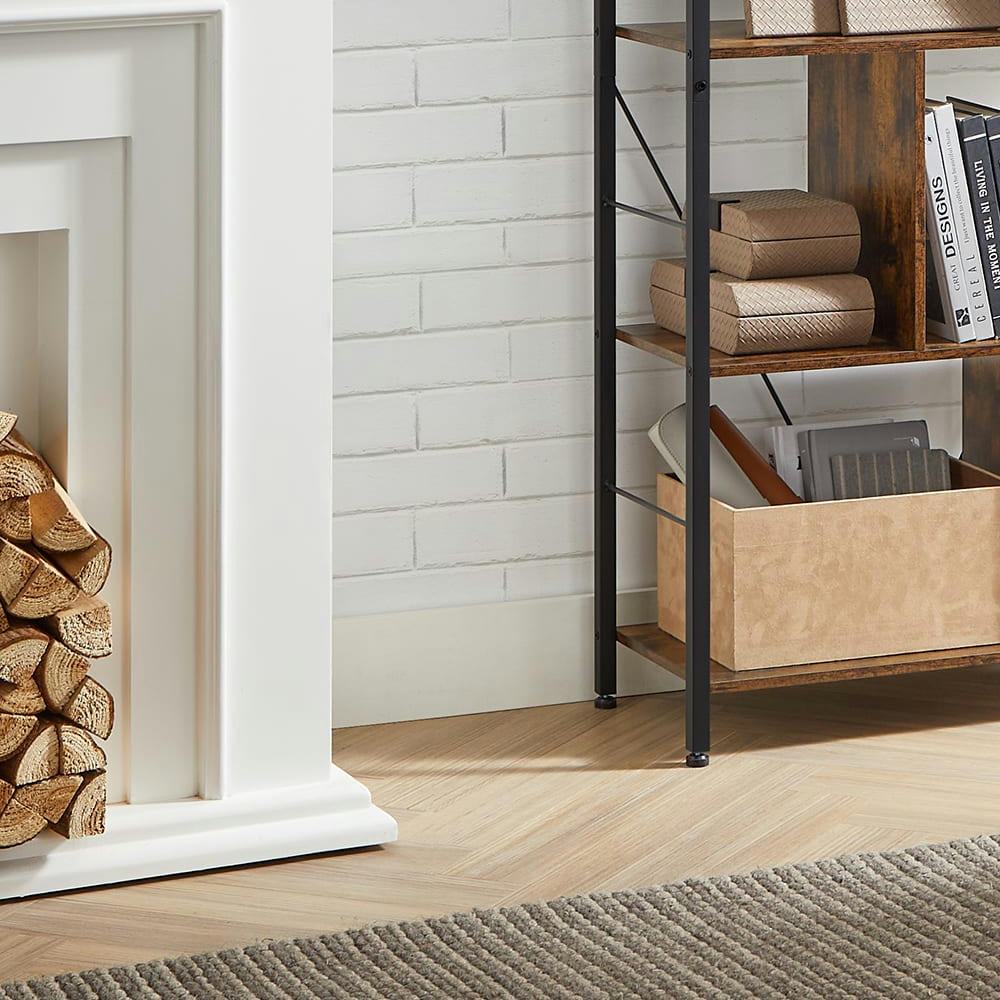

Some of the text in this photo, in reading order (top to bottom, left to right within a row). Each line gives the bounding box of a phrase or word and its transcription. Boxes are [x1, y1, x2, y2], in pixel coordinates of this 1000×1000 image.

[974, 160, 988, 198] LIVING
[932, 176, 957, 258] DESIGNS
[980, 201, 991, 214] IN
[983, 216, 995, 240] THE
[966, 254, 987, 322] CEREAL
